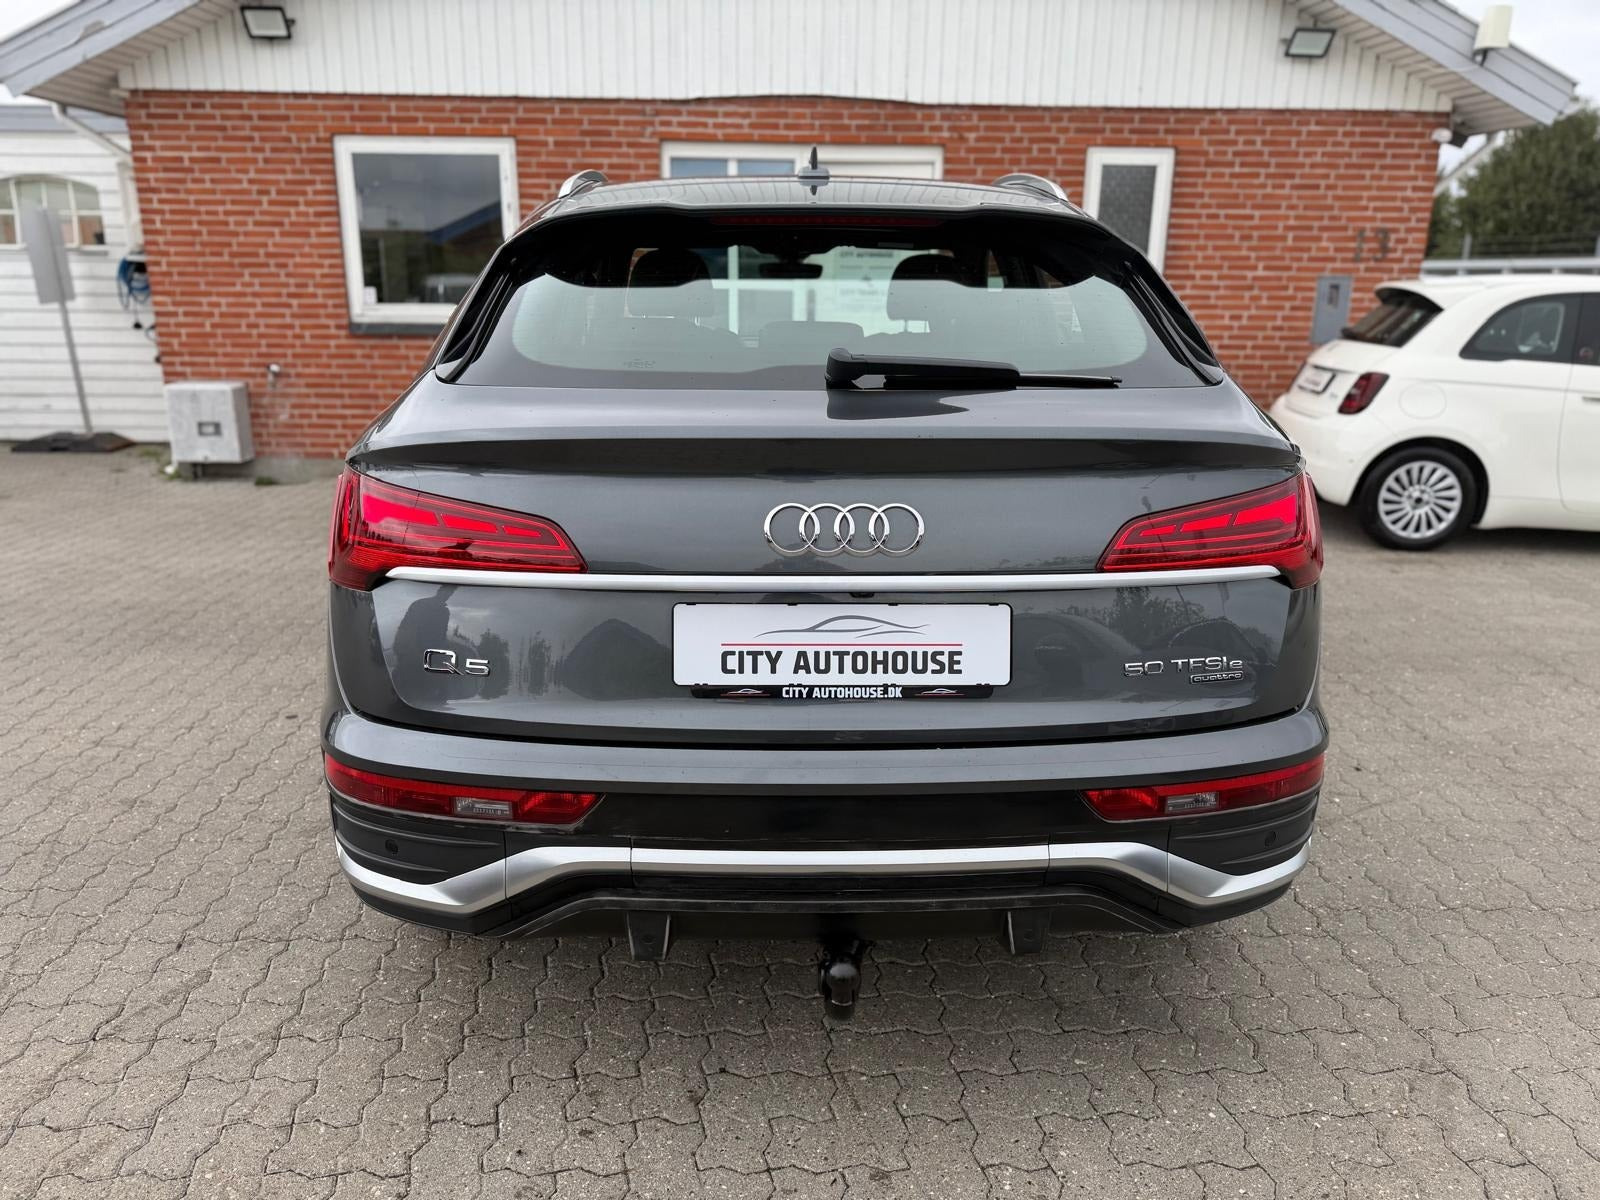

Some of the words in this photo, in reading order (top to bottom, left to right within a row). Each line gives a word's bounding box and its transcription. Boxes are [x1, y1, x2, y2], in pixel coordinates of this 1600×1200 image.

[423, 648, 491, 676] Q5
[720, 650, 782, 675] CITY
[793, 650, 963, 675] AUTOHOUSE
[1124, 660, 1164, 676] 50
[1193, 672, 1242, 682] quattro
[782, 686, 809, 699] CITY
[812, 686, 903, 699] AUTOHOUSE.DK
